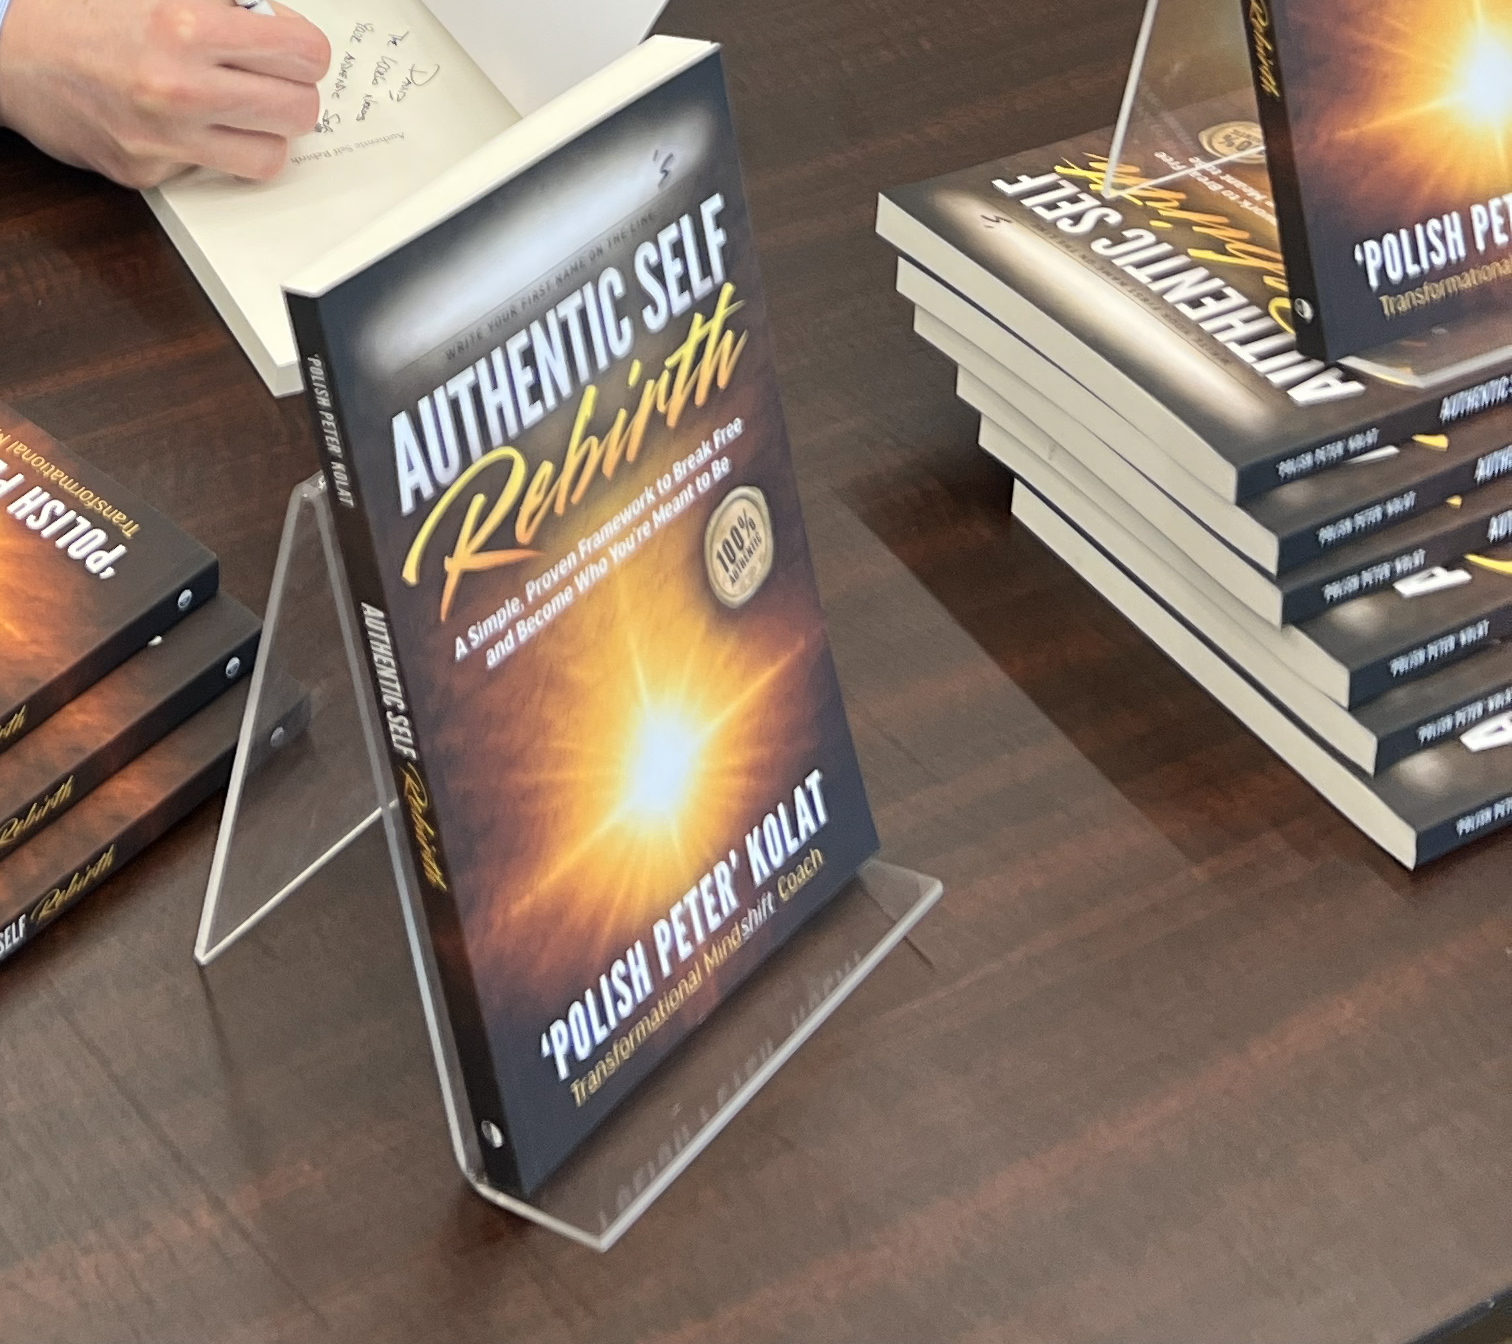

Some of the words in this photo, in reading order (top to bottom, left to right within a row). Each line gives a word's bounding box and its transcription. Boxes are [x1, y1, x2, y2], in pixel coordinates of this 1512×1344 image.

[991, 172, 1123, 235] SELF
[392, 266, 633, 515] AUTHENTIC
[634, 192, 728, 334] SELF
[402, 282, 750, 623] Rebirth
[468, 596, 525, 649] Simple,
[525, 552, 578, 604] Proven
[578, 486, 657, 560] Framework
[672, 441, 712, 481] Break
[712, 417, 744, 450] Free
[516, 585, 574, 645] Become
[575, 556, 609, 595] Who
[609, 524, 652, 569] You're
[651, 483, 695, 529] Meant
[715, 508, 757, 576] 100%
[29, 844, 117, 923] Rebirth
[745, 768, 830, 890] KOLAT
[569, 965, 704, 1109] Transformational
[703, 893, 778, 976] Mindshift
[777, 844, 825, 903] Coach
